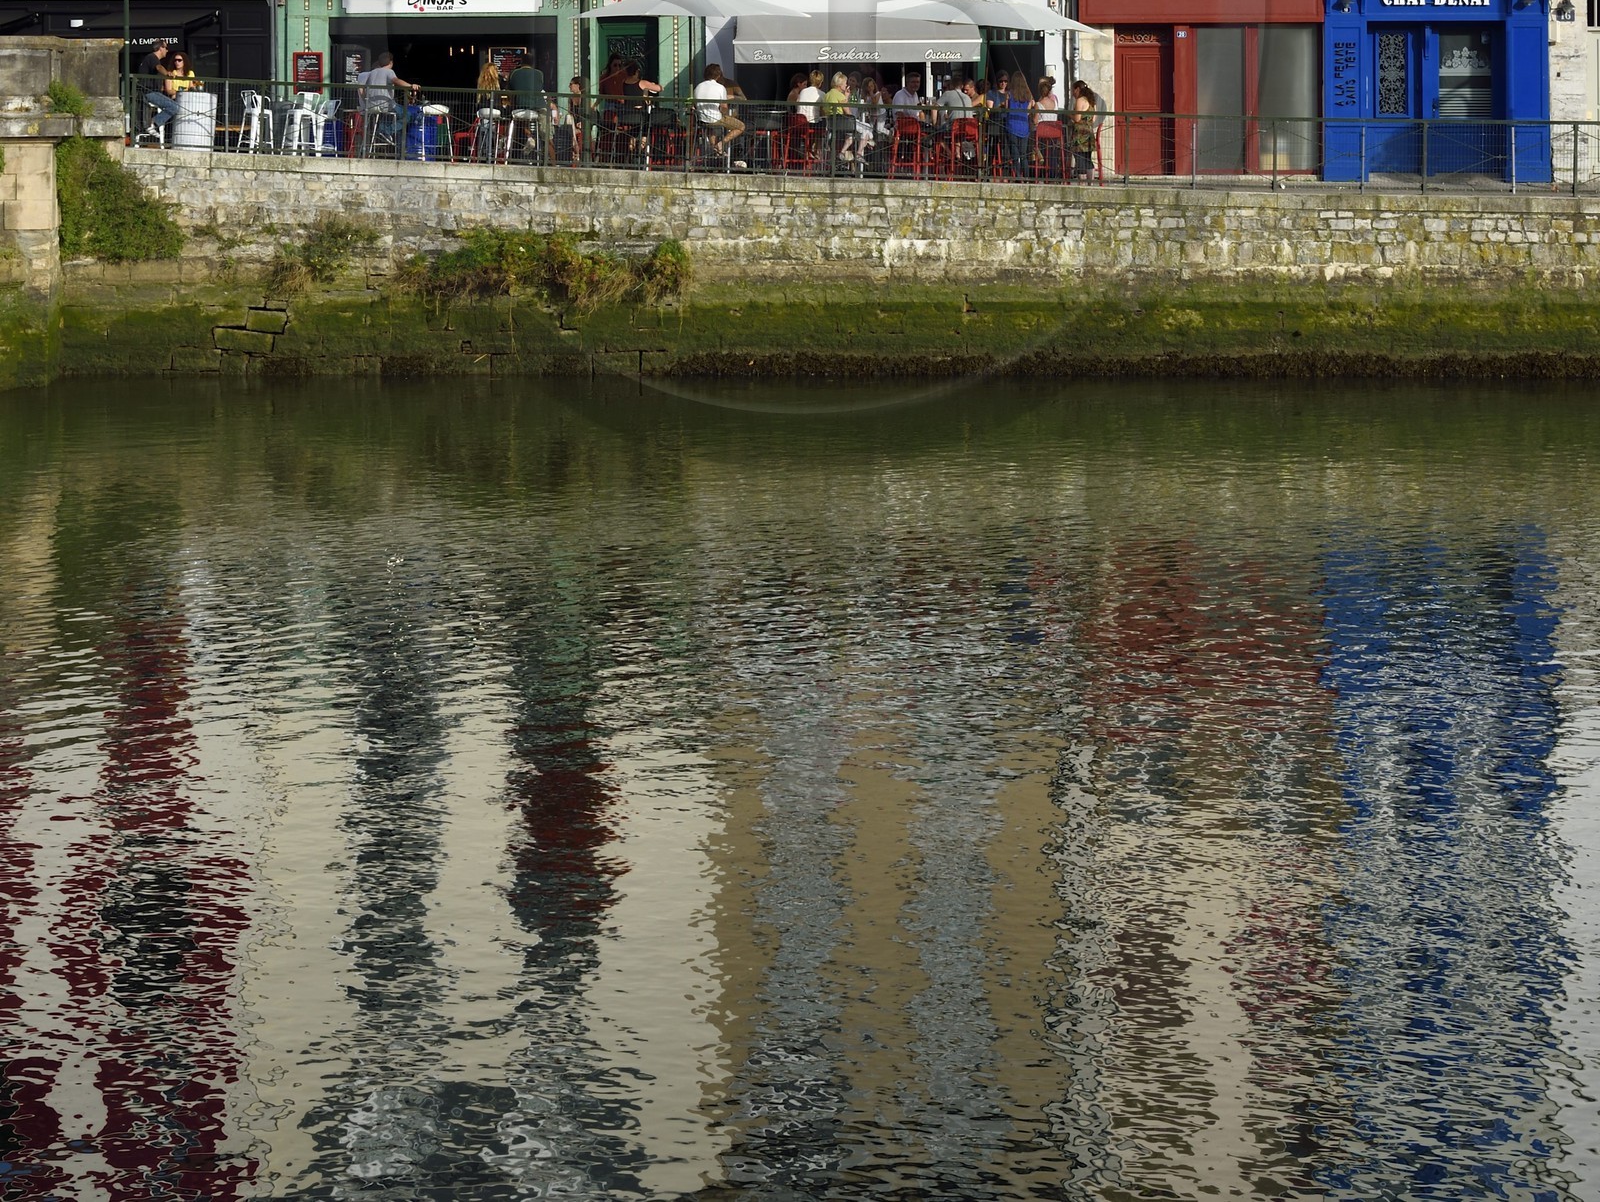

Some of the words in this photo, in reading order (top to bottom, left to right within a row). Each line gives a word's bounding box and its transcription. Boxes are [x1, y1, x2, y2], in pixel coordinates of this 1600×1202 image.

[139, 37, 179, 45] EMPTER
[753, 50, 773, 61] Bar
[817, 46, 881, 61] Sankara
[924, 48, 962, 60] Ostatua
[1334, 42, 1344, 78] FEMME
